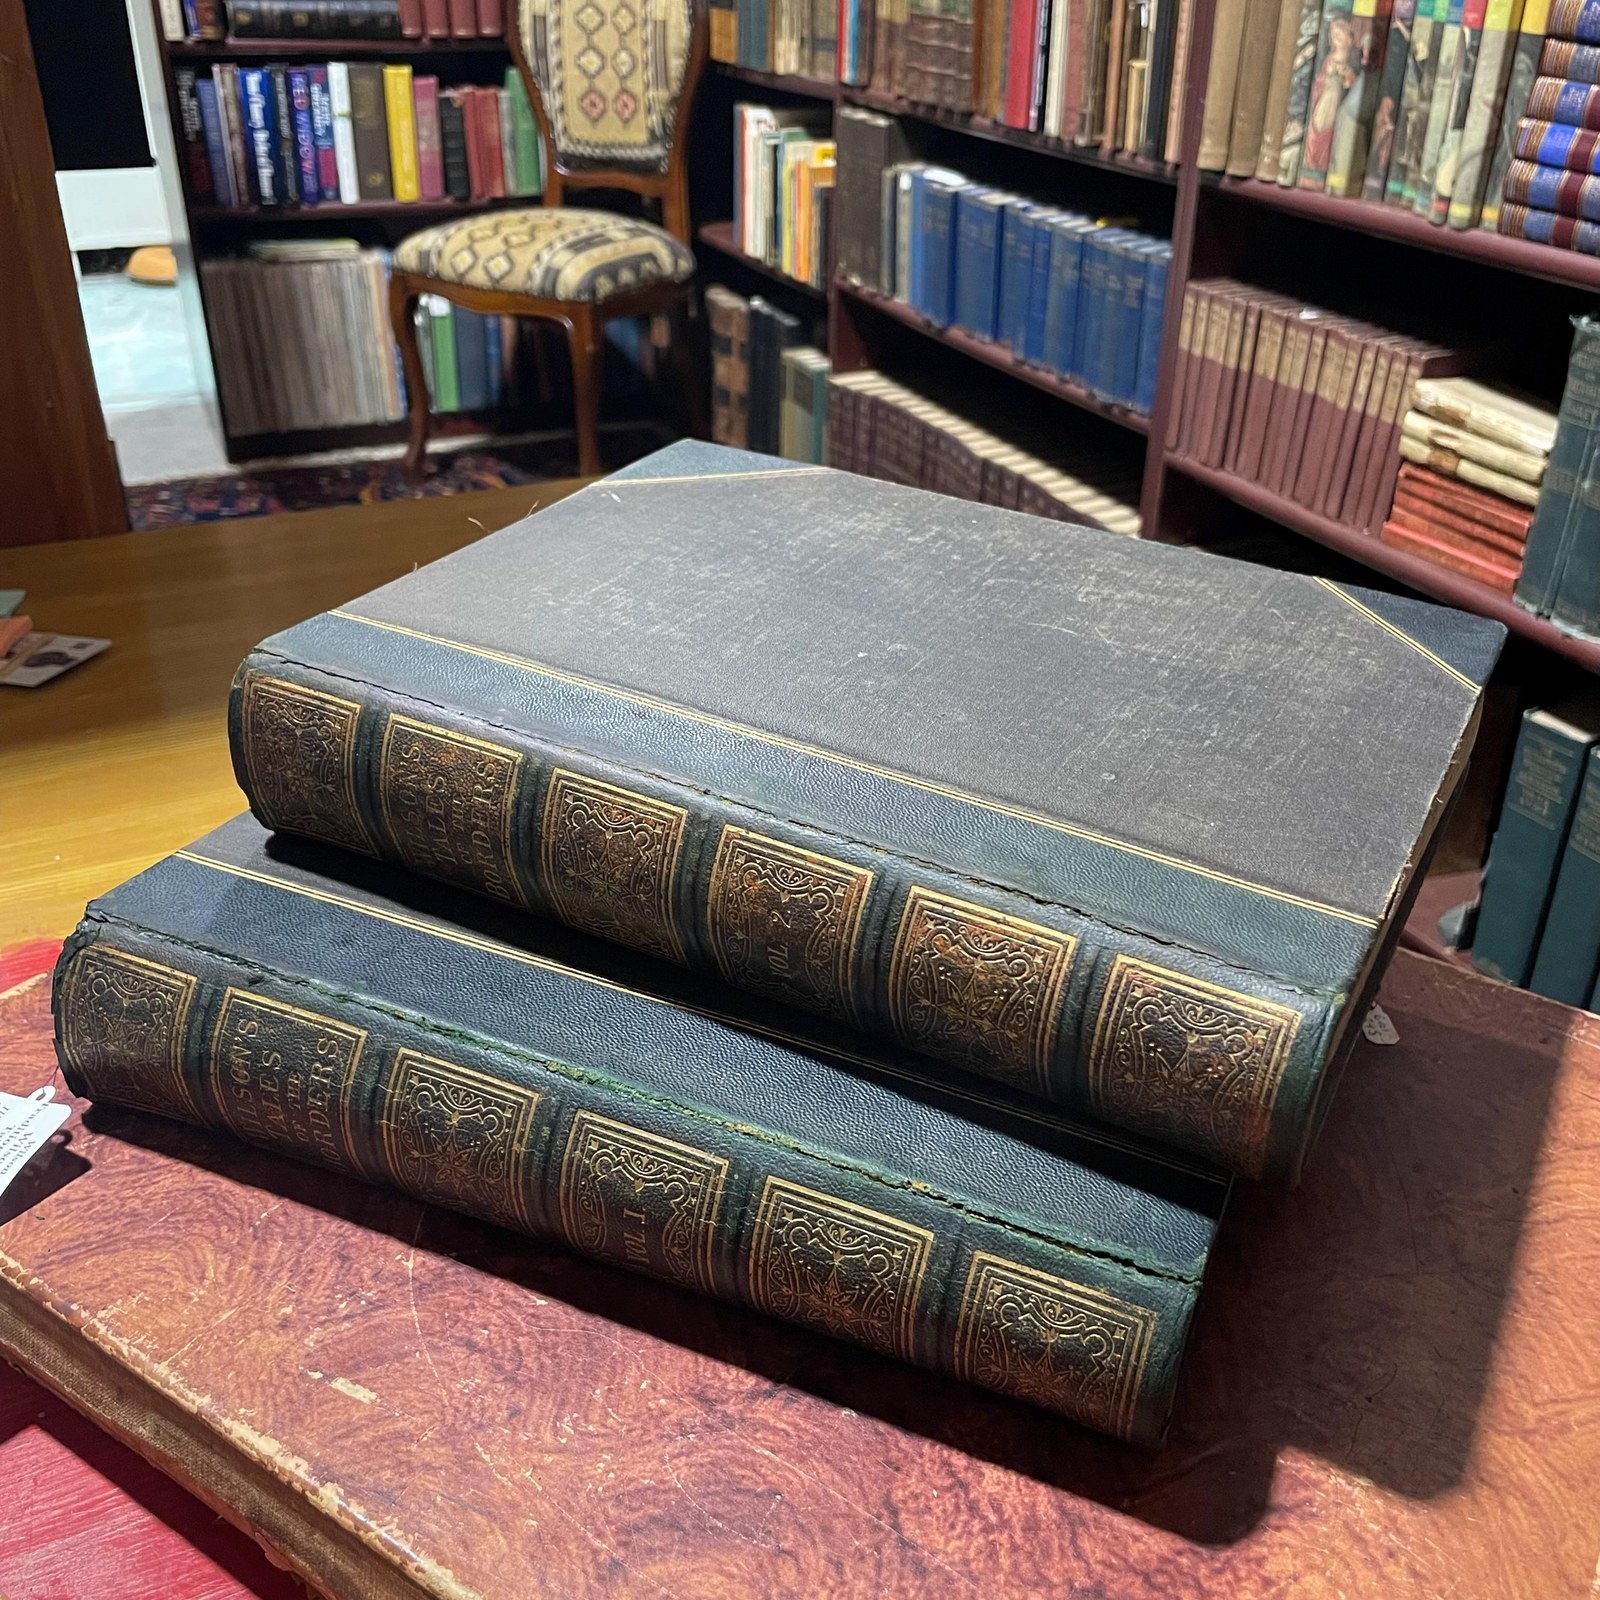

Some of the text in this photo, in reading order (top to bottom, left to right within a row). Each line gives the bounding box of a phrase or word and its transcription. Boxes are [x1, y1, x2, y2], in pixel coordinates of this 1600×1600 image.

[291, 76, 309, 111] RED
[296, 111, 316, 175] WIDOW
[398, 743, 436, 864] WILSON'S
[426, 772, 458, 865] TALES
[451, 793, 473, 864] OF THE
[471, 760, 511, 898] BORDERS
[229, 1018, 268, 1141] WILSON'S
[258, 1049, 293, 1142] TALES
[288, 1069, 309, 1142] OF THE
